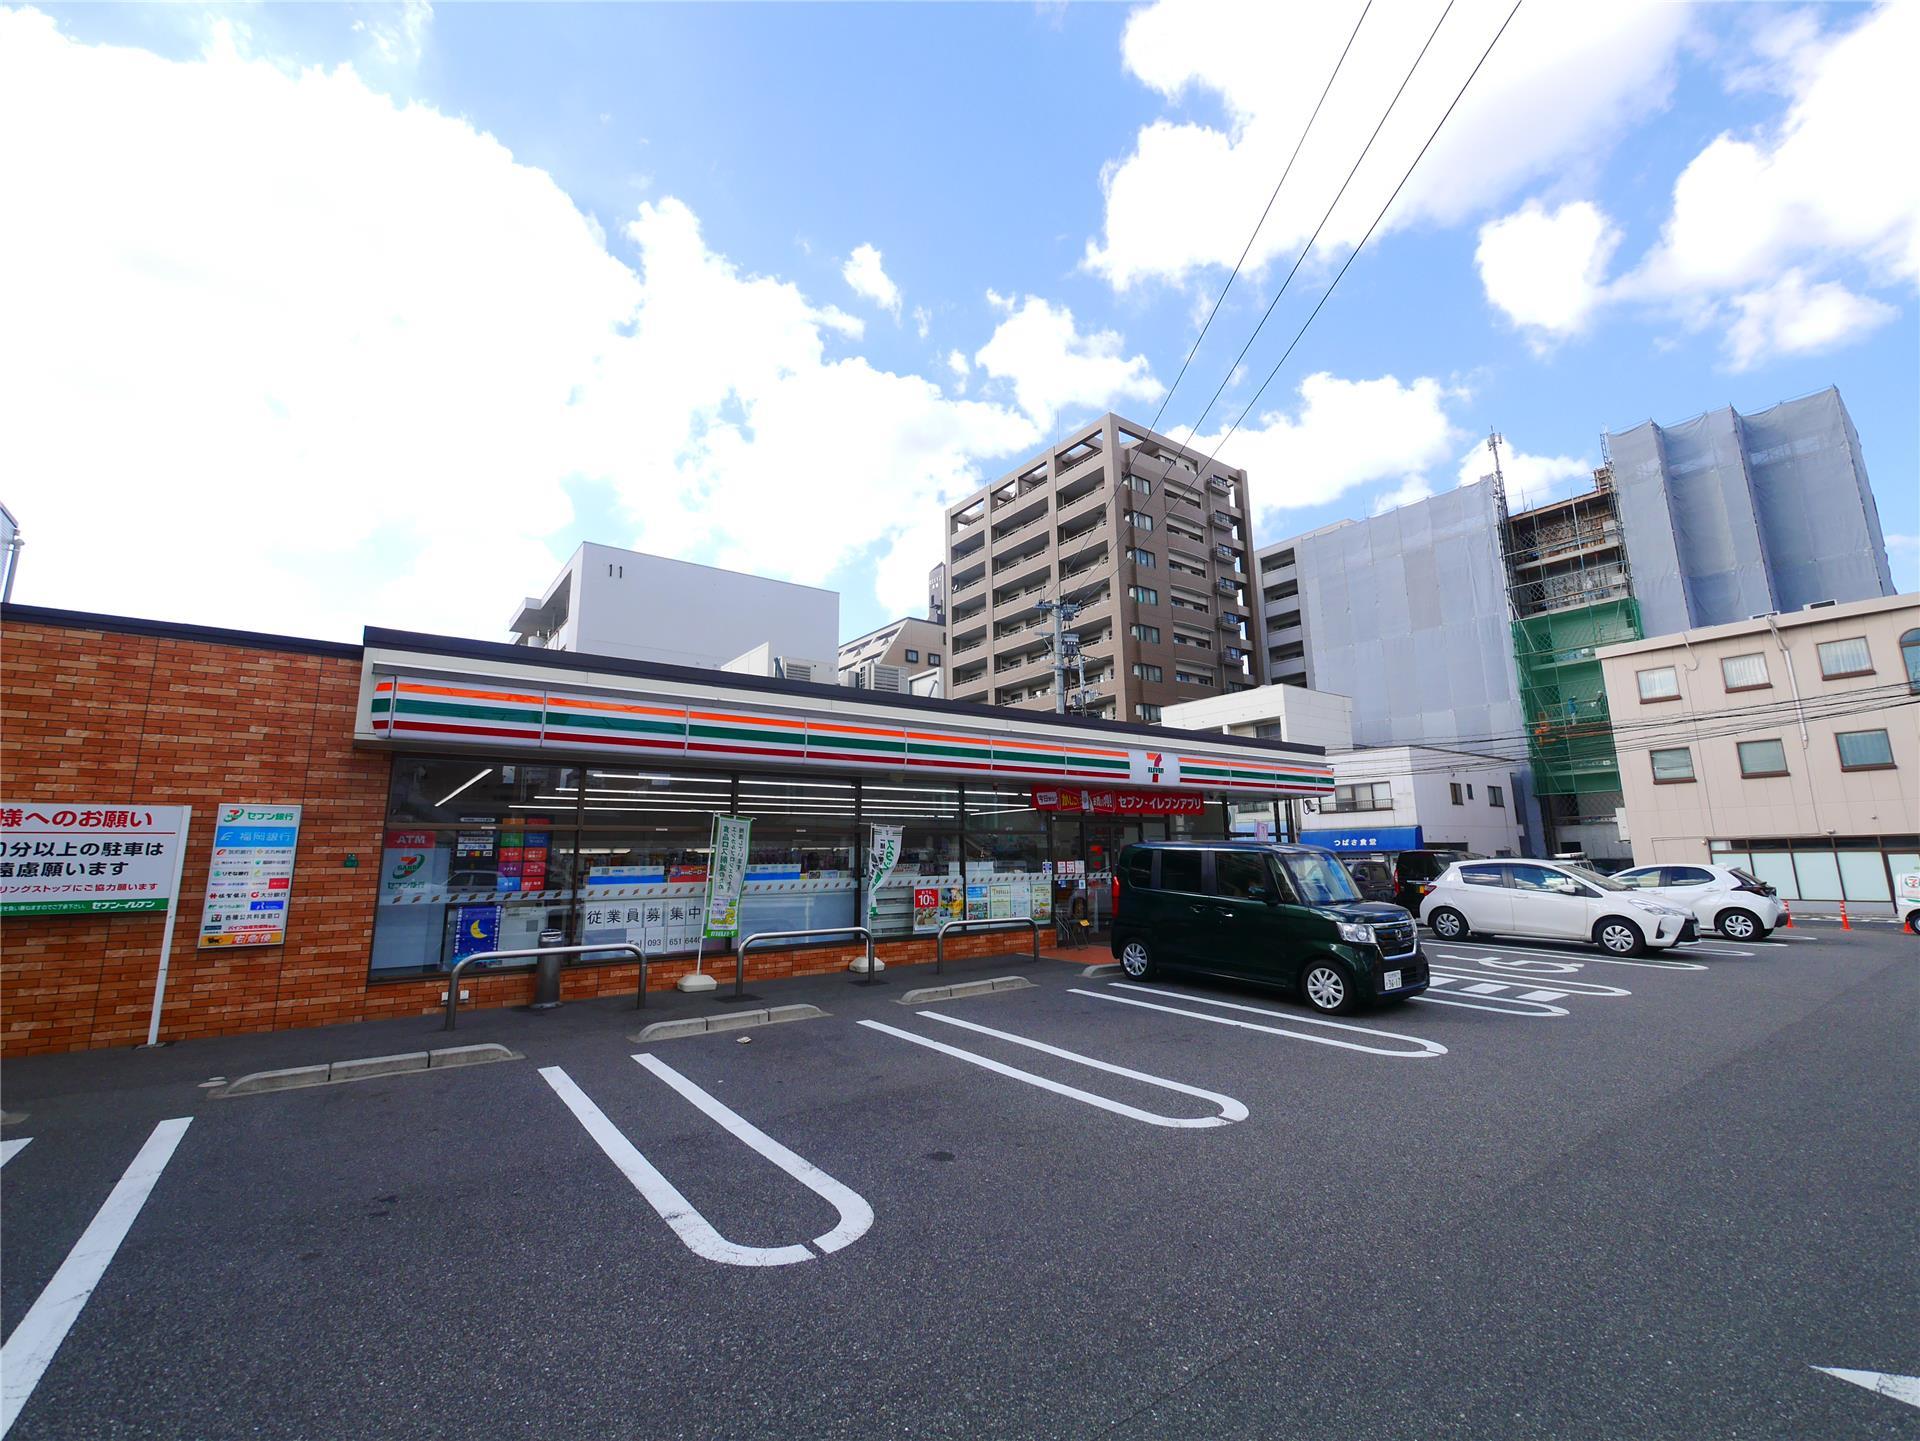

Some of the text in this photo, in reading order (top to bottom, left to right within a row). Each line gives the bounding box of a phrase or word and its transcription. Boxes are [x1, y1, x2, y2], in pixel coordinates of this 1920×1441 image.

[0, 808, 153, 828] 様へのお願い
[247, 812, 294, 821] セブン銀行
[239, 831, 291, 841] 福岡銀行
[396, 834, 425, 844] ATM
[1333, 837, 1378, 847] つばさ食堂
[0, 862, 129, 877] 遠慮願います
[225, 913, 280, 921] 各種公共料金窓口
[587, 906, 701, 925] 従業員募集中
[234, 934, 272, 944] 宅急便
[647, 939, 662, 947] 093
[669, 937, 682, 946] 651
